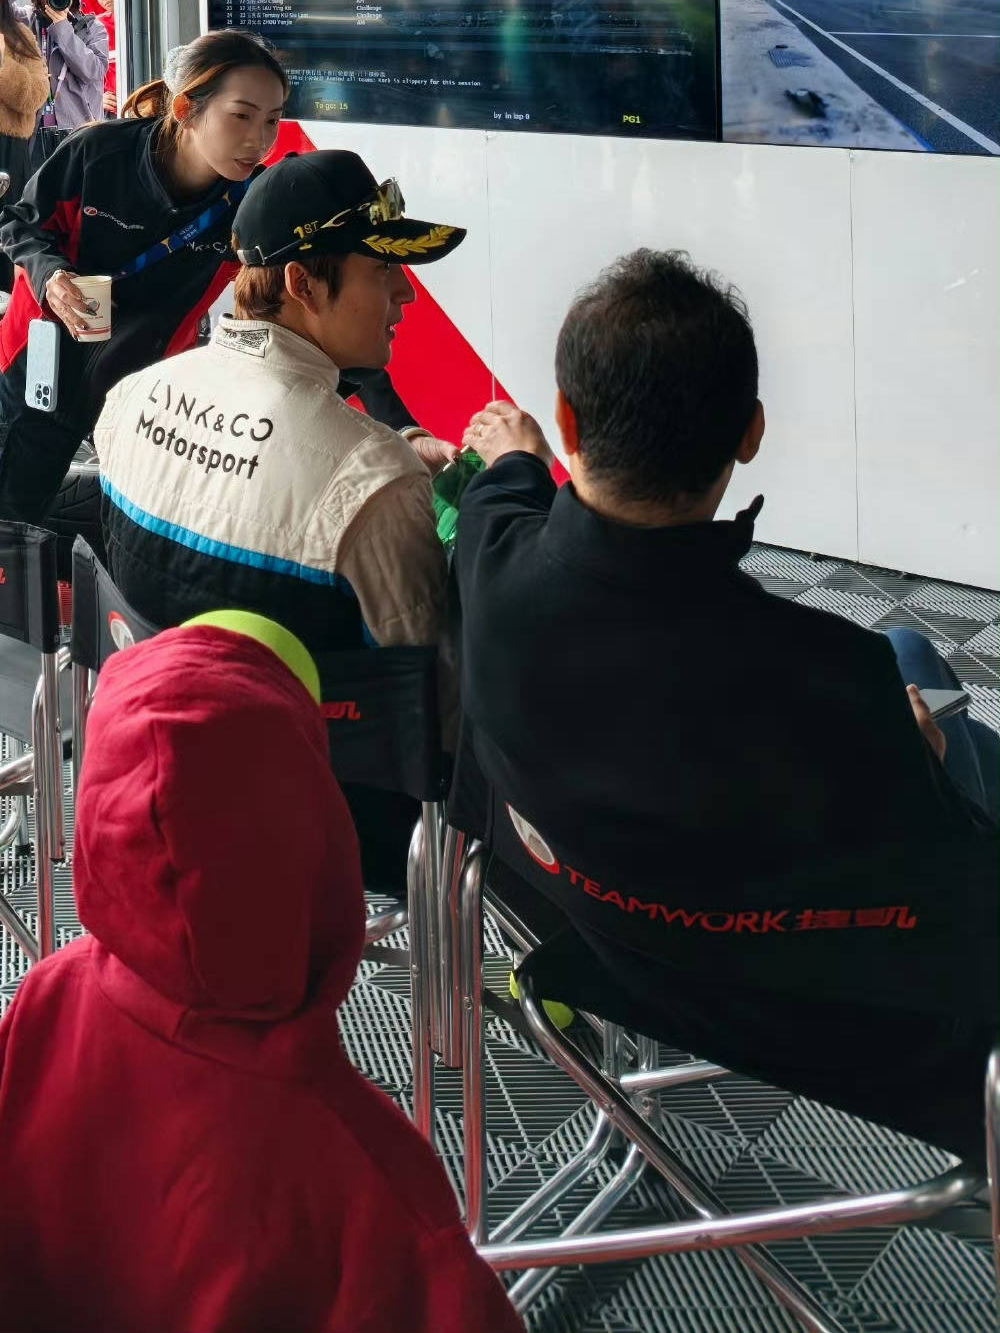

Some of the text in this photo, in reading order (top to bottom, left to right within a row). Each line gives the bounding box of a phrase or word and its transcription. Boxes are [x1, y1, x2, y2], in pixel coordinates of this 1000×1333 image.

[514, 112, 523, 120] lap
[623, 115, 641, 123] PG1
[136, 409, 259, 480] Motorsport
[562, 865, 790, 932] TEAMWORK
